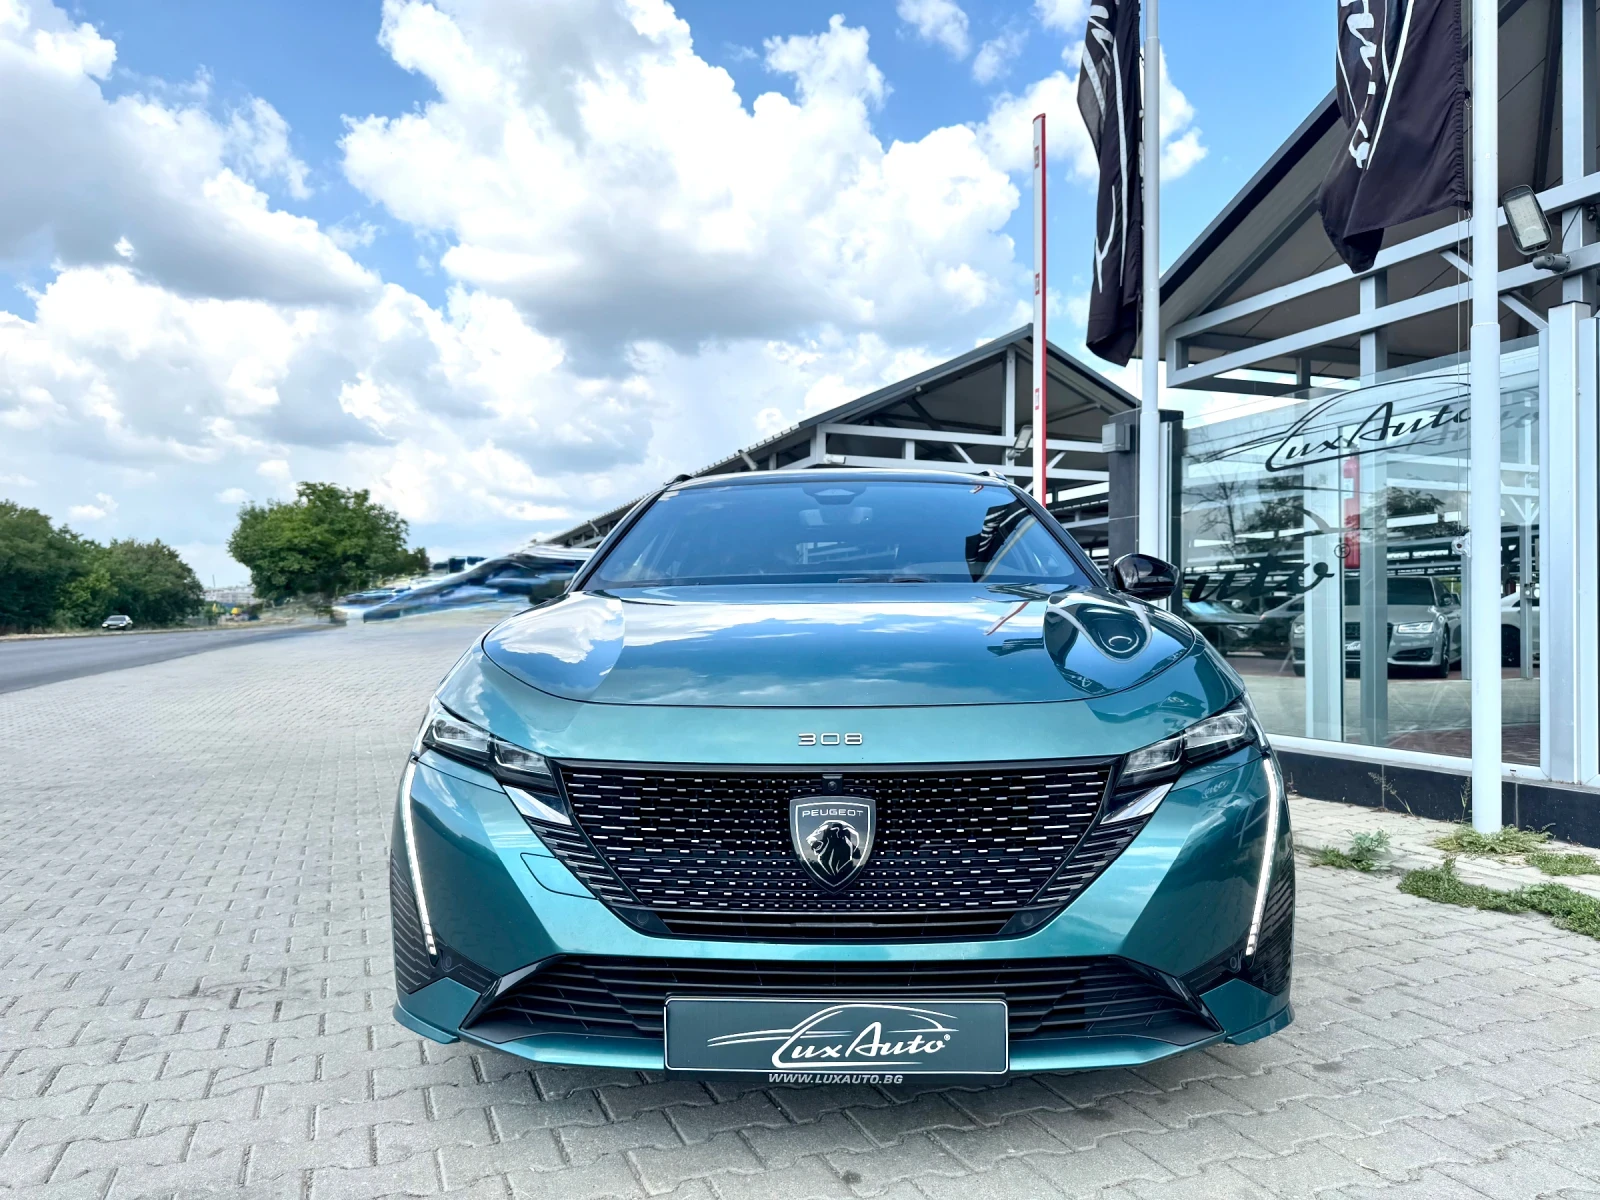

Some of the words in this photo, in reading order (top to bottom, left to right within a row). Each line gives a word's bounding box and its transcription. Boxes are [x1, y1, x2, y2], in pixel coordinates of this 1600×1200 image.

[798, 733, 863, 745] 308
[802, 808, 864, 817] PEUGEOT
[768, 1073, 904, 1084] WWW.LUXAUTO.BG
